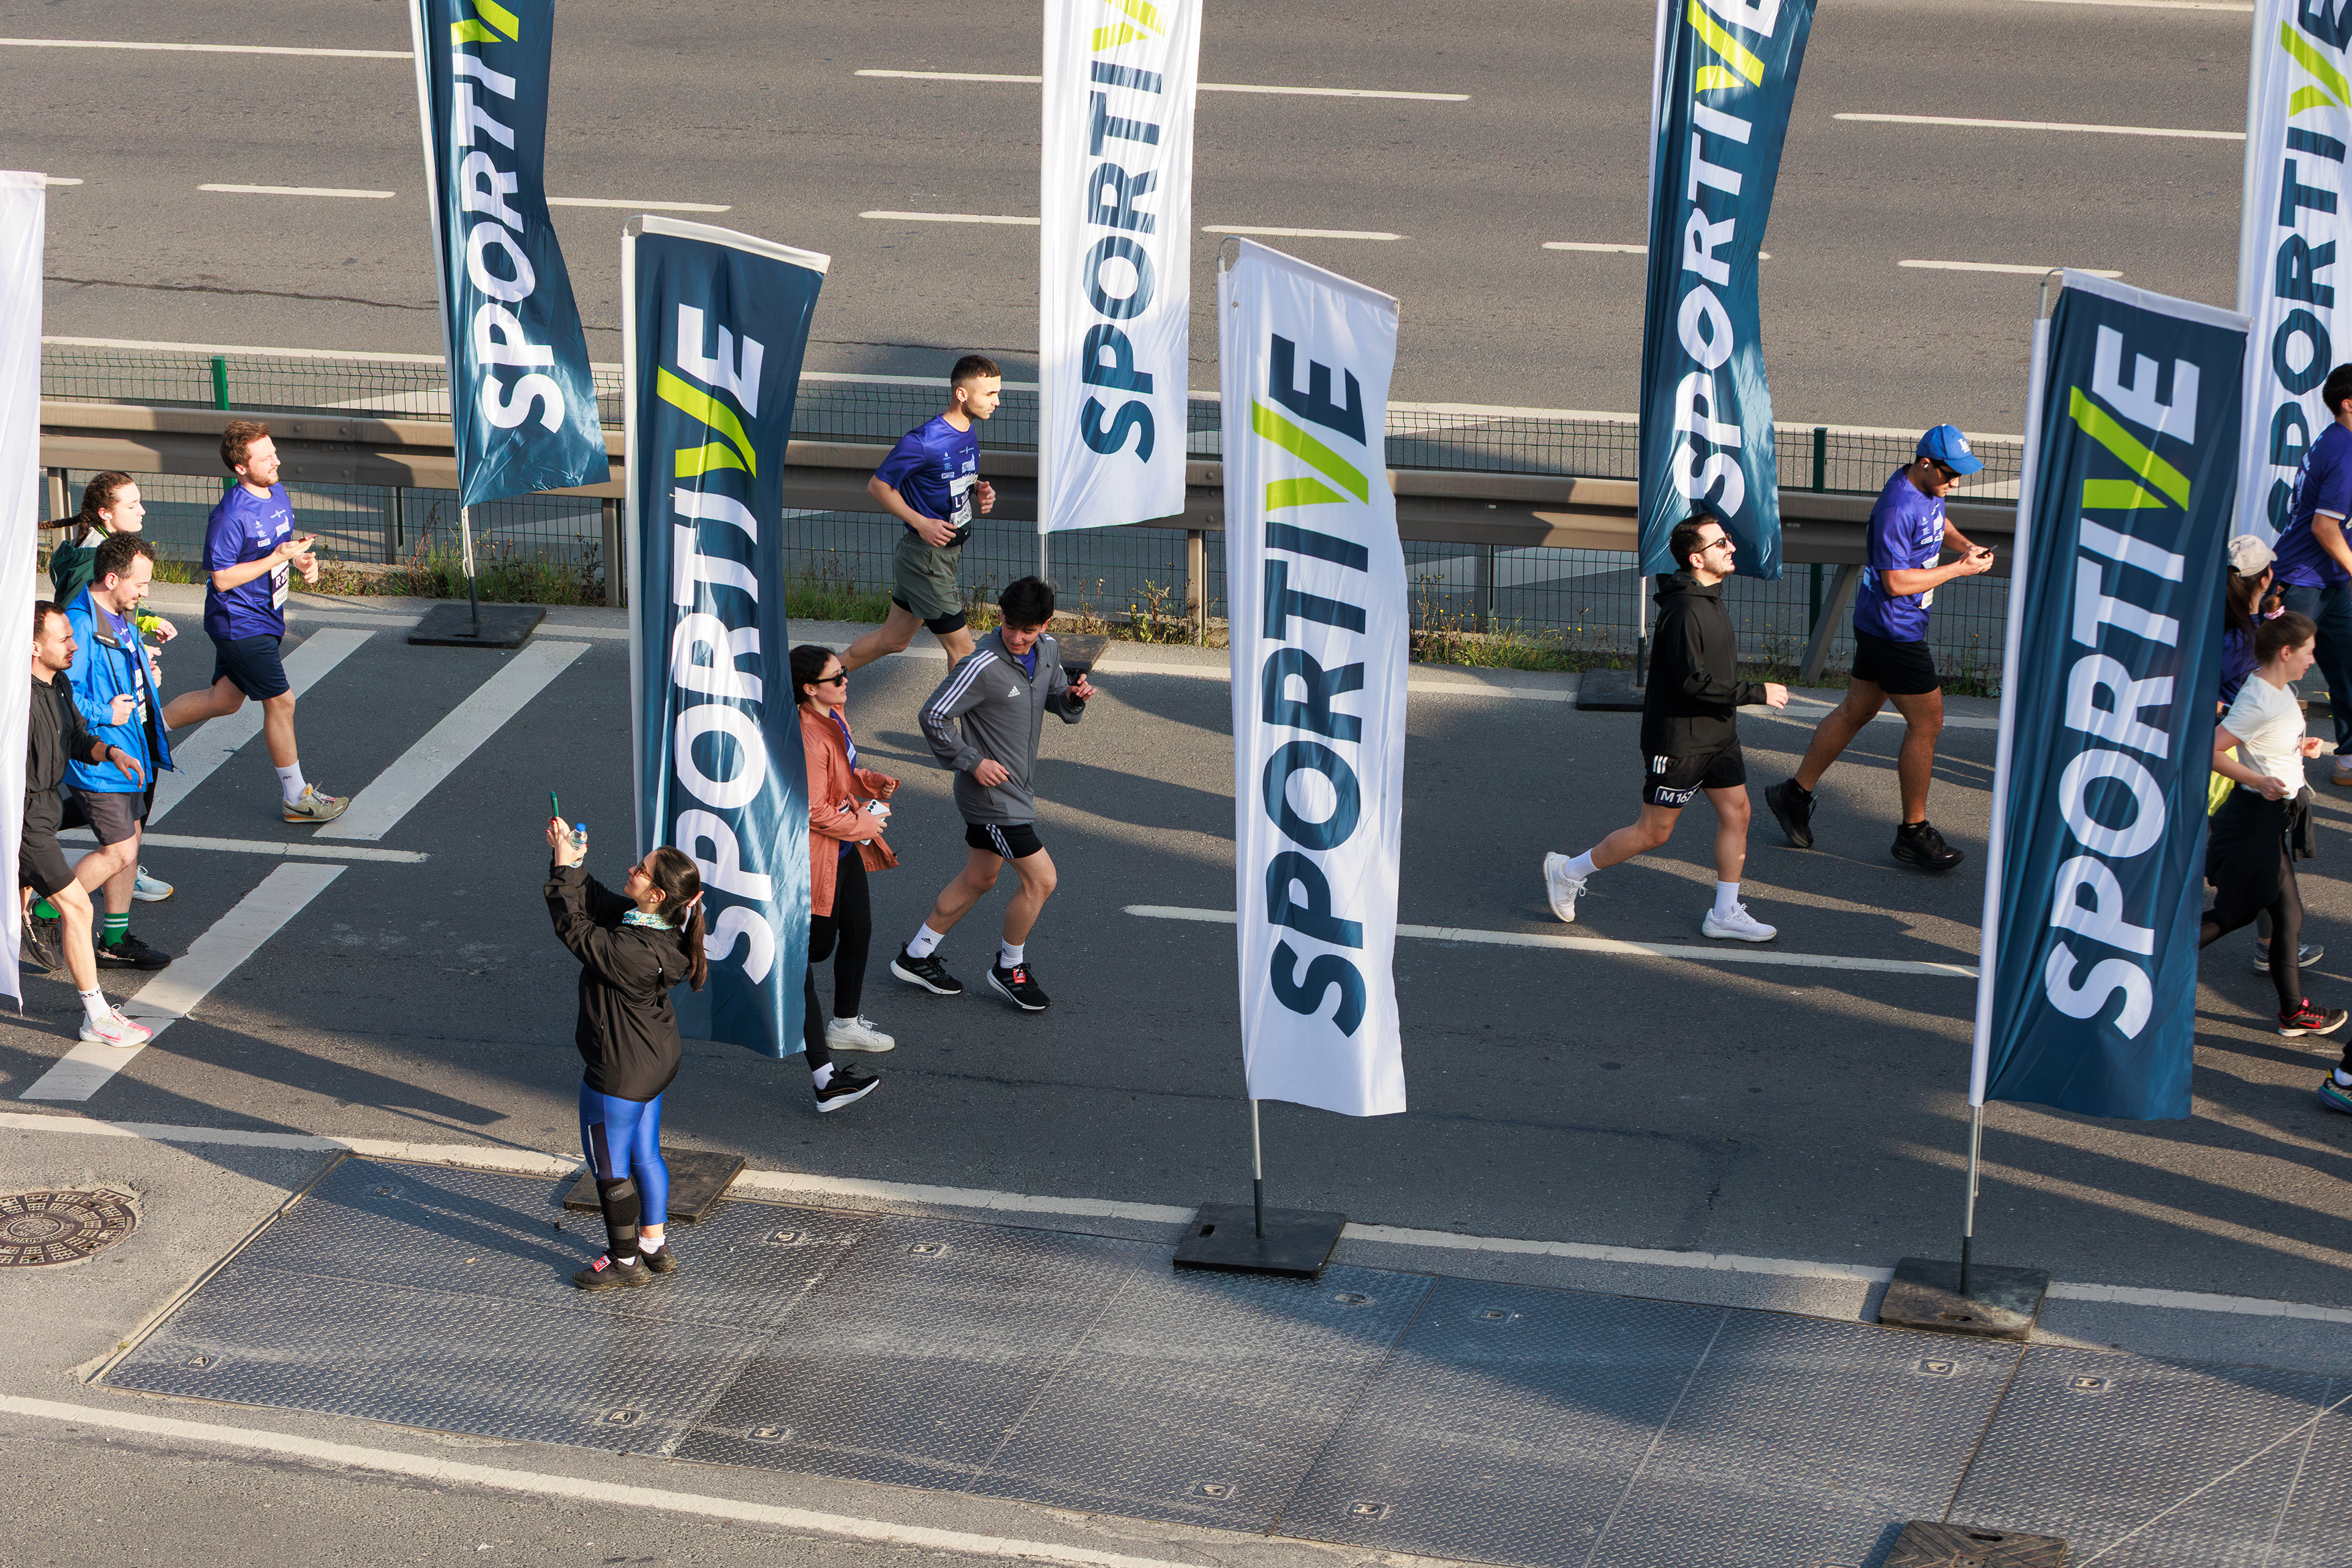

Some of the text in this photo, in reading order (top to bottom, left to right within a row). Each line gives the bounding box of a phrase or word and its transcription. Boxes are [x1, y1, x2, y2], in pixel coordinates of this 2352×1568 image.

[657, 303, 775, 985] SPORTIVE
[1252, 333, 1368, 1038] SPORTIVE
[2045, 325, 2200, 1039] SPORTIVE
[611, 1188, 624, 1197] LYON
